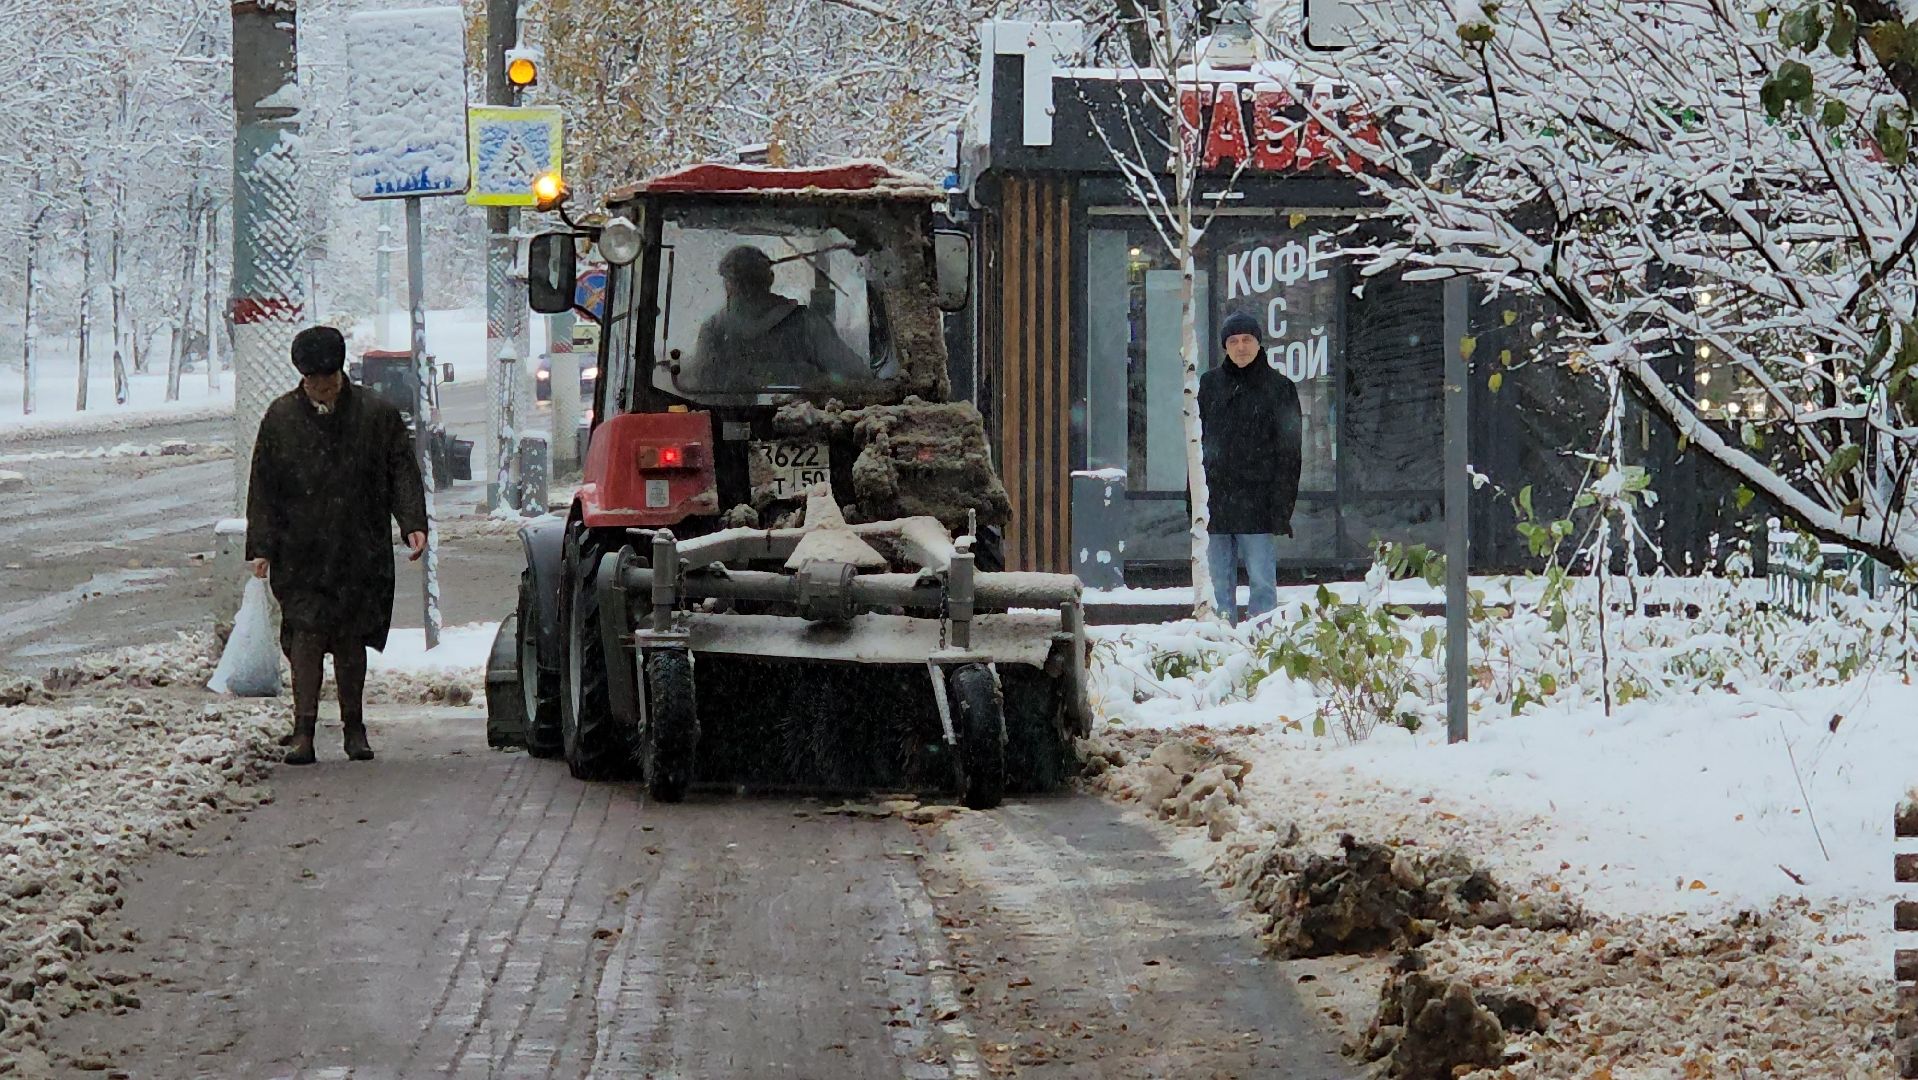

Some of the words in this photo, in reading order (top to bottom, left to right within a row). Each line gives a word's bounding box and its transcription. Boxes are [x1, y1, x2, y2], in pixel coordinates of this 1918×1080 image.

[1227, 234, 1331, 299] КОФЕ
[1267, 296, 1287, 338] С
[1266, 326, 1328, 383] БОЙ
